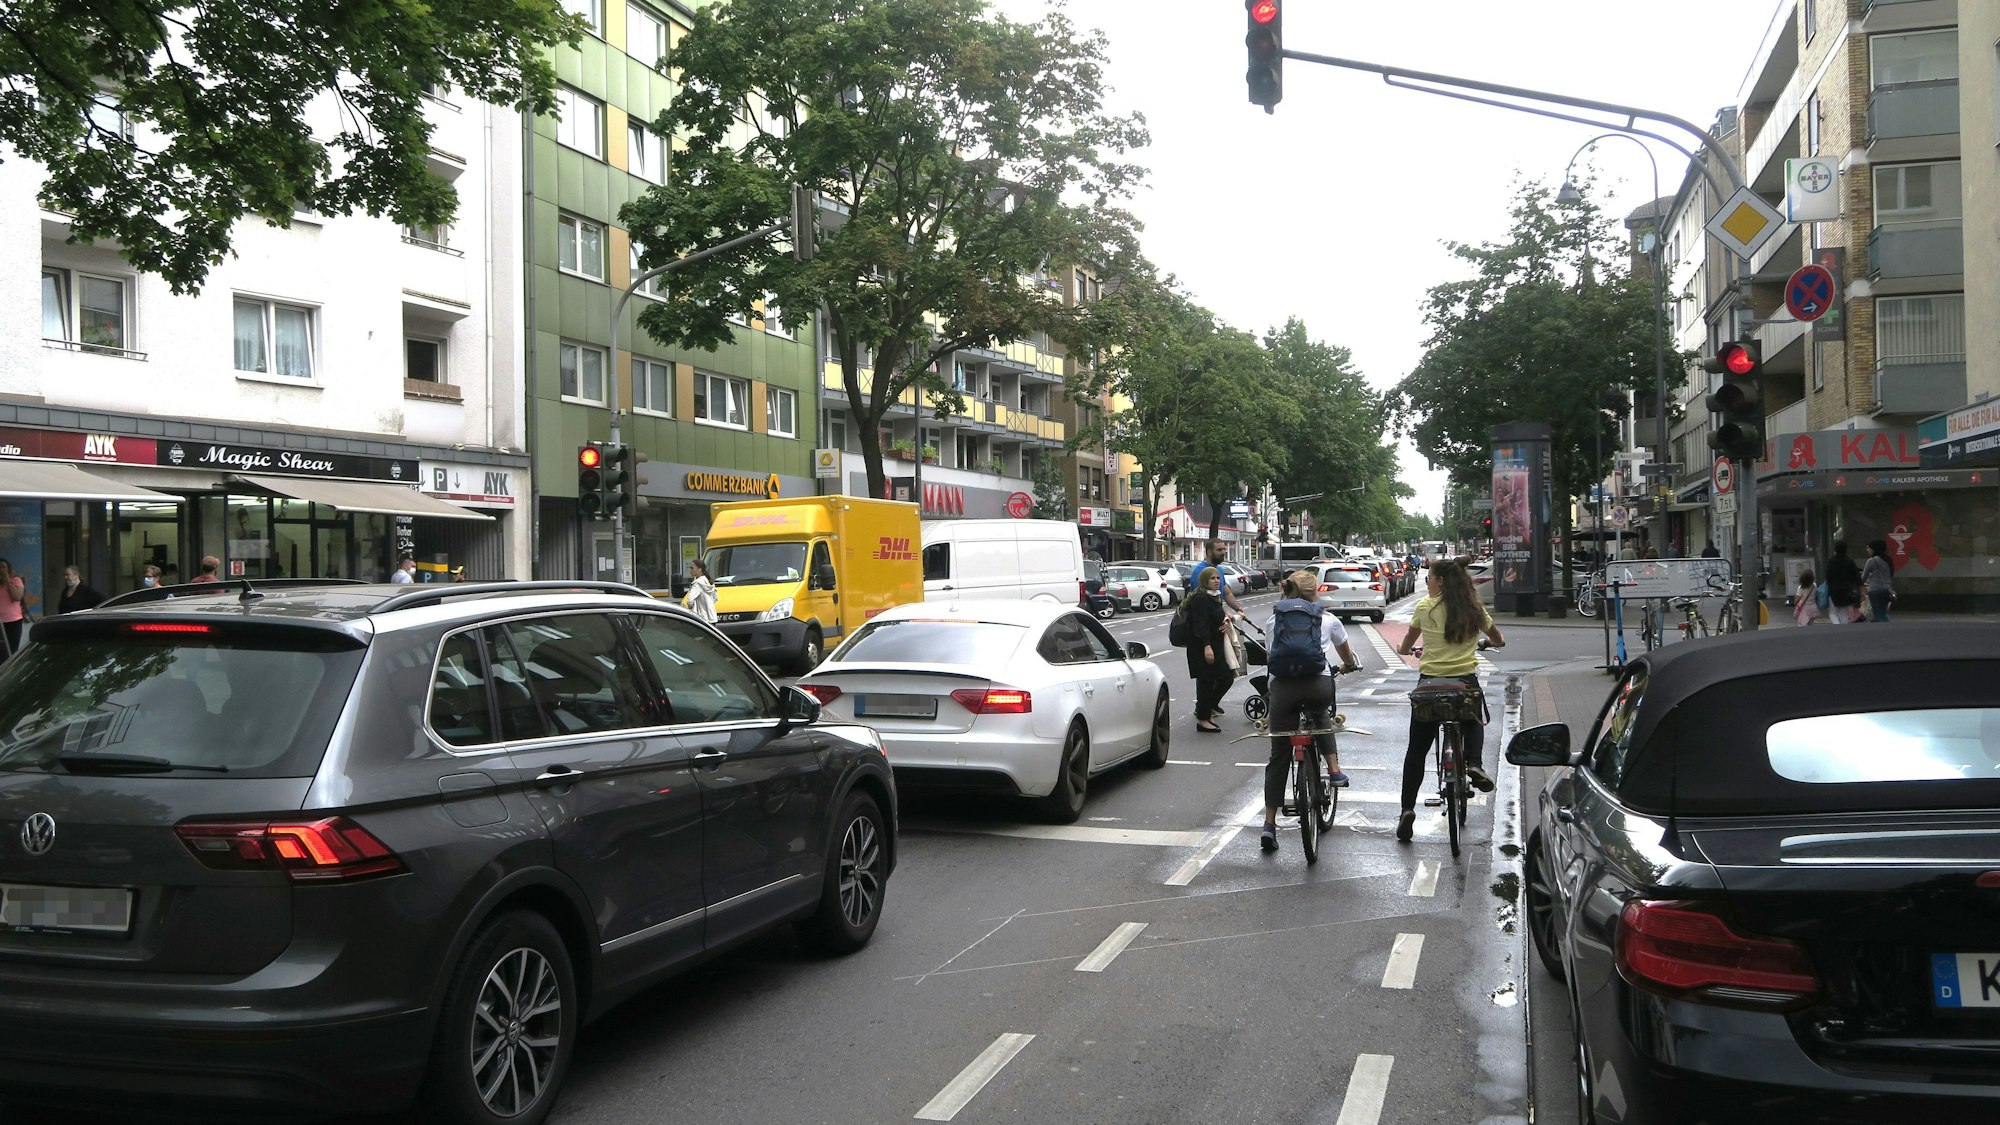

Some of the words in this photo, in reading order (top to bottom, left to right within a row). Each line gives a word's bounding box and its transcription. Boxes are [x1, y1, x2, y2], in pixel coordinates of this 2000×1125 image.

[1800, 174, 1829, 182] BAYER
[84, 434, 117, 456] AYK
[1841, 432, 1920, 464] KAL
[199, 446, 272, 471] Magic
[278, 452, 334, 472] Shear
[483, 471, 509, 495] AYK
[687, 472, 768, 496] COMMERZBANK
[1892, 476, 1916, 484] KALKER
[1917, 475, 1949, 483] APOTHEKE
[731, 514, 790, 528] DHL
[879, 536, 912, 560] DHL
[717, 613, 740, 621] VECO
[1941, 985, 1952, 998] D
[1978, 959, 2000, 1001] K
